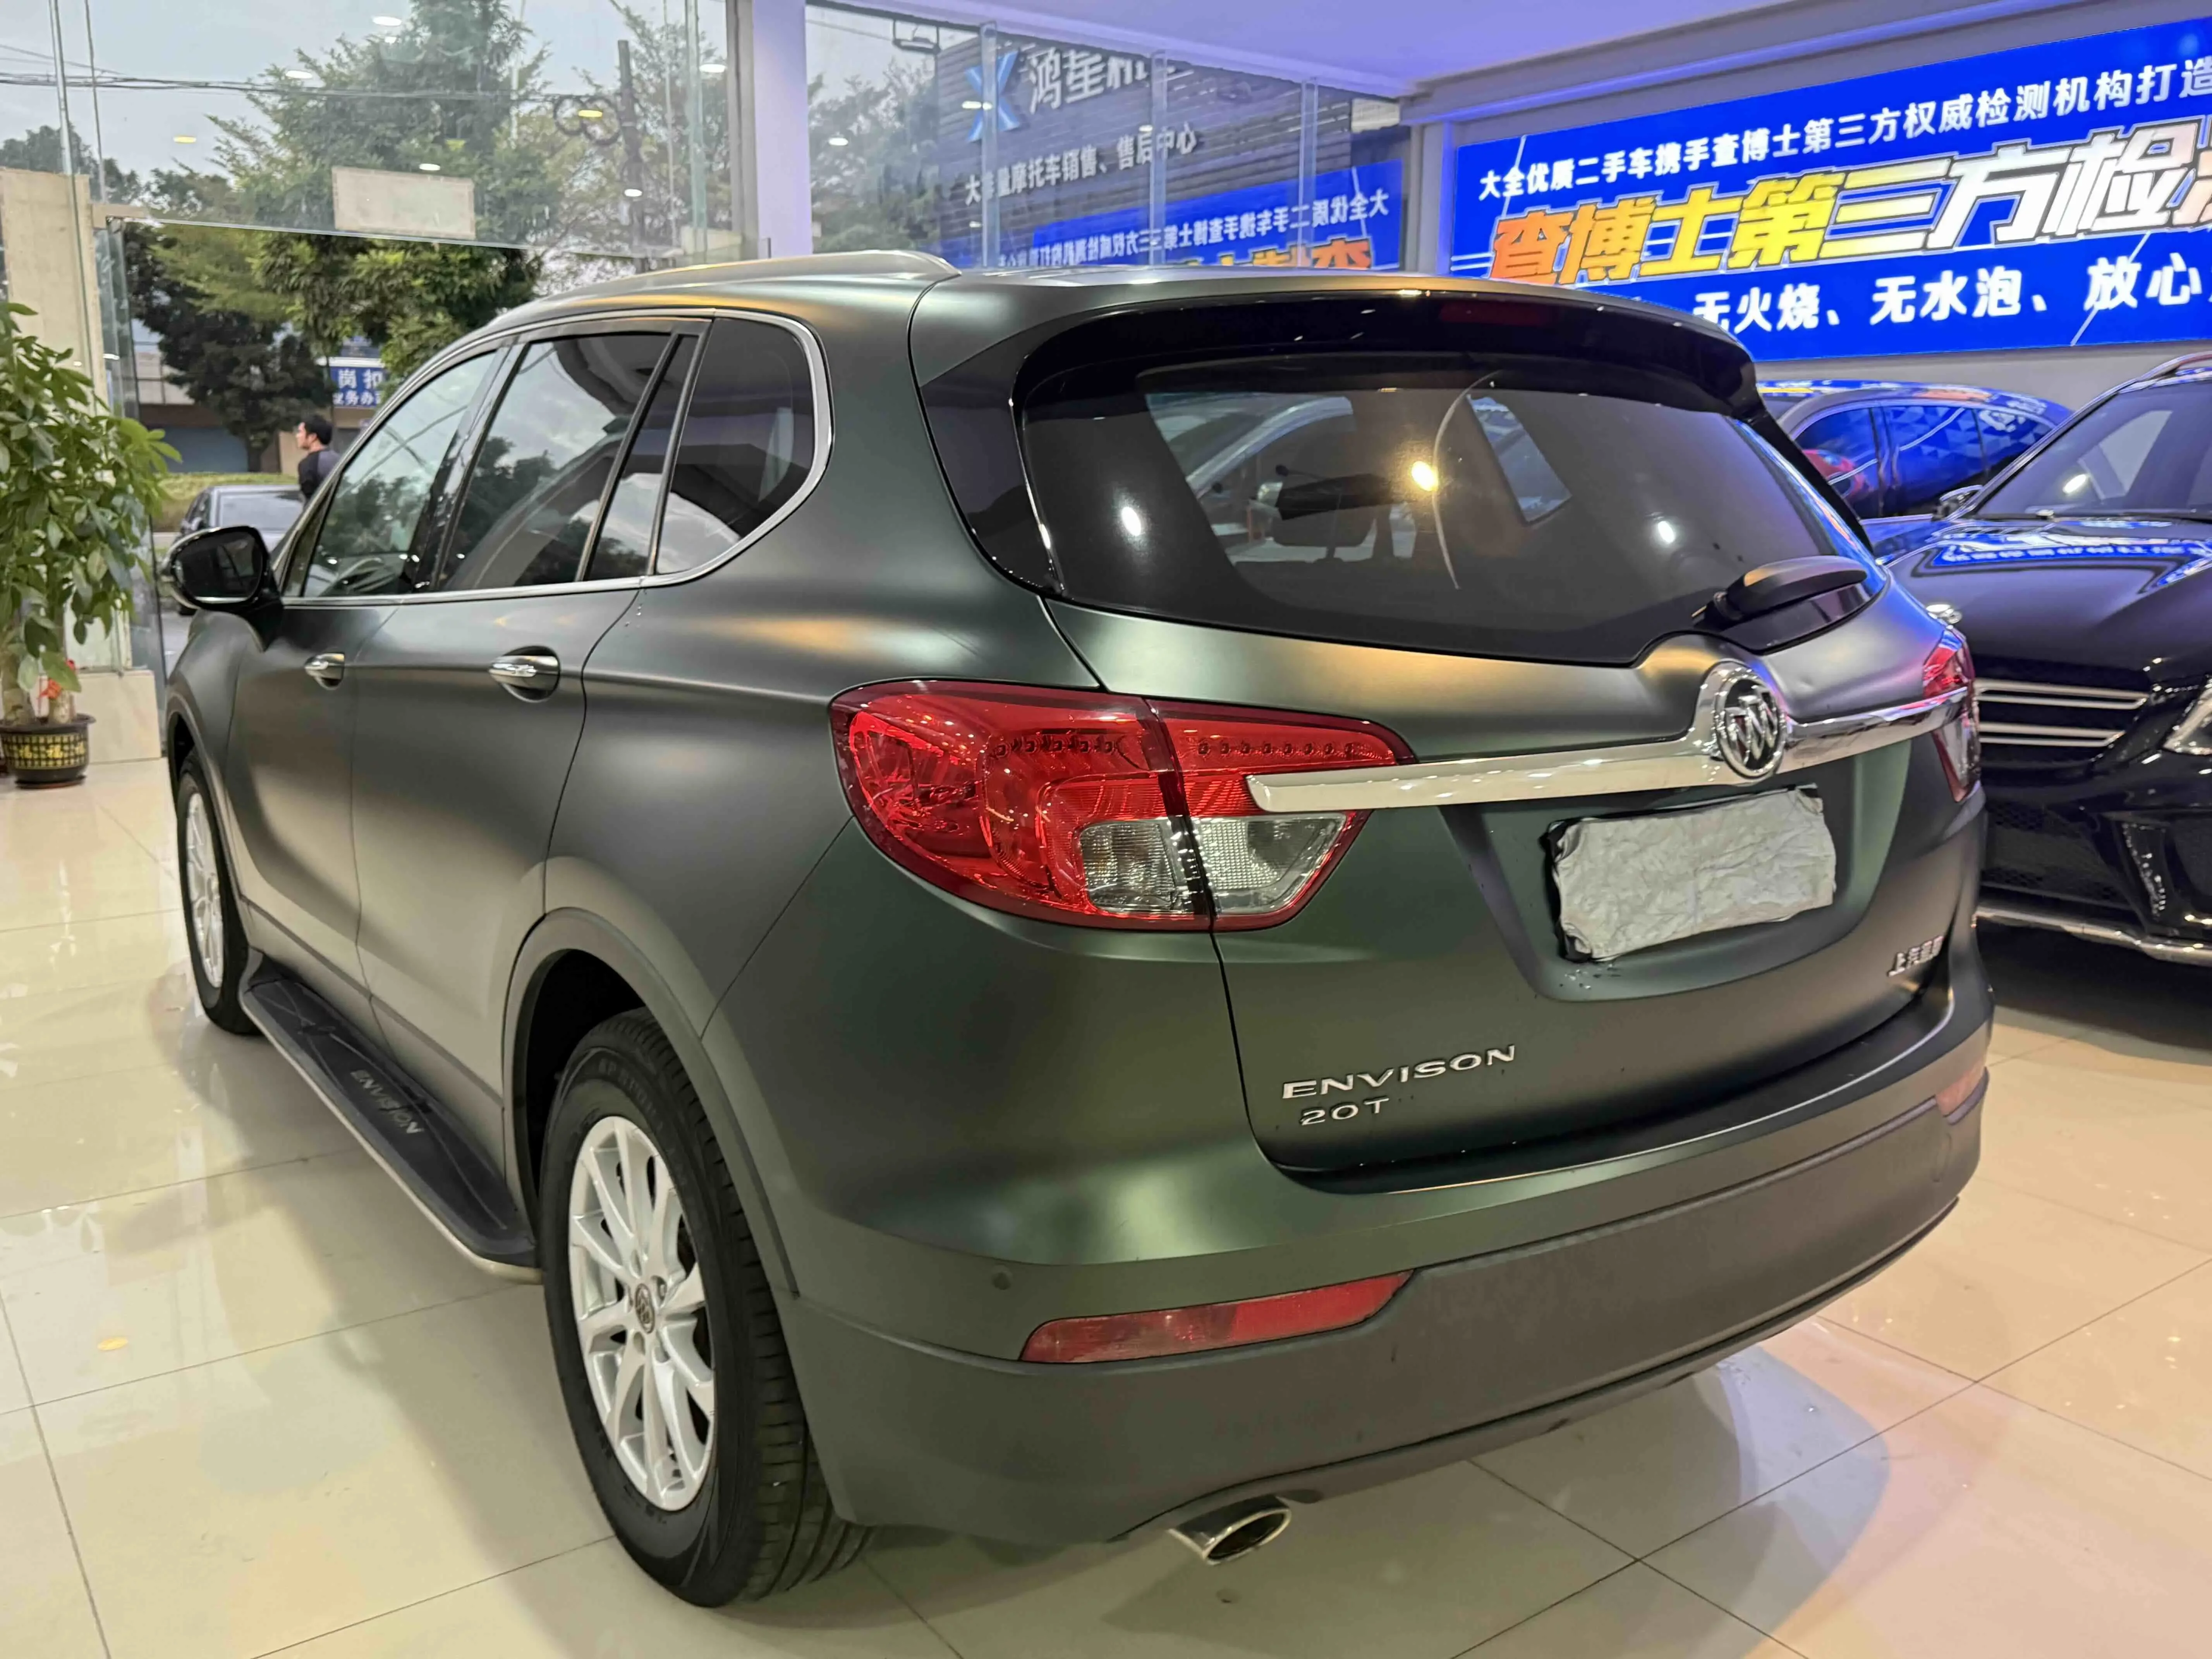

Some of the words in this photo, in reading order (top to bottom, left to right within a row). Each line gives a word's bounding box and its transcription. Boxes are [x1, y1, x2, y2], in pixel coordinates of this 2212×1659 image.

[1479, 56, 2212, 201] 大全优质二手车携手查博士第三方权威检测机构打造
[1693, 252, 2212, 334] 无火烧、无水泡、放心
[1282, 1044, 1515, 1099] ENVISON
[1300, 1097, 1389, 1125] 20T
